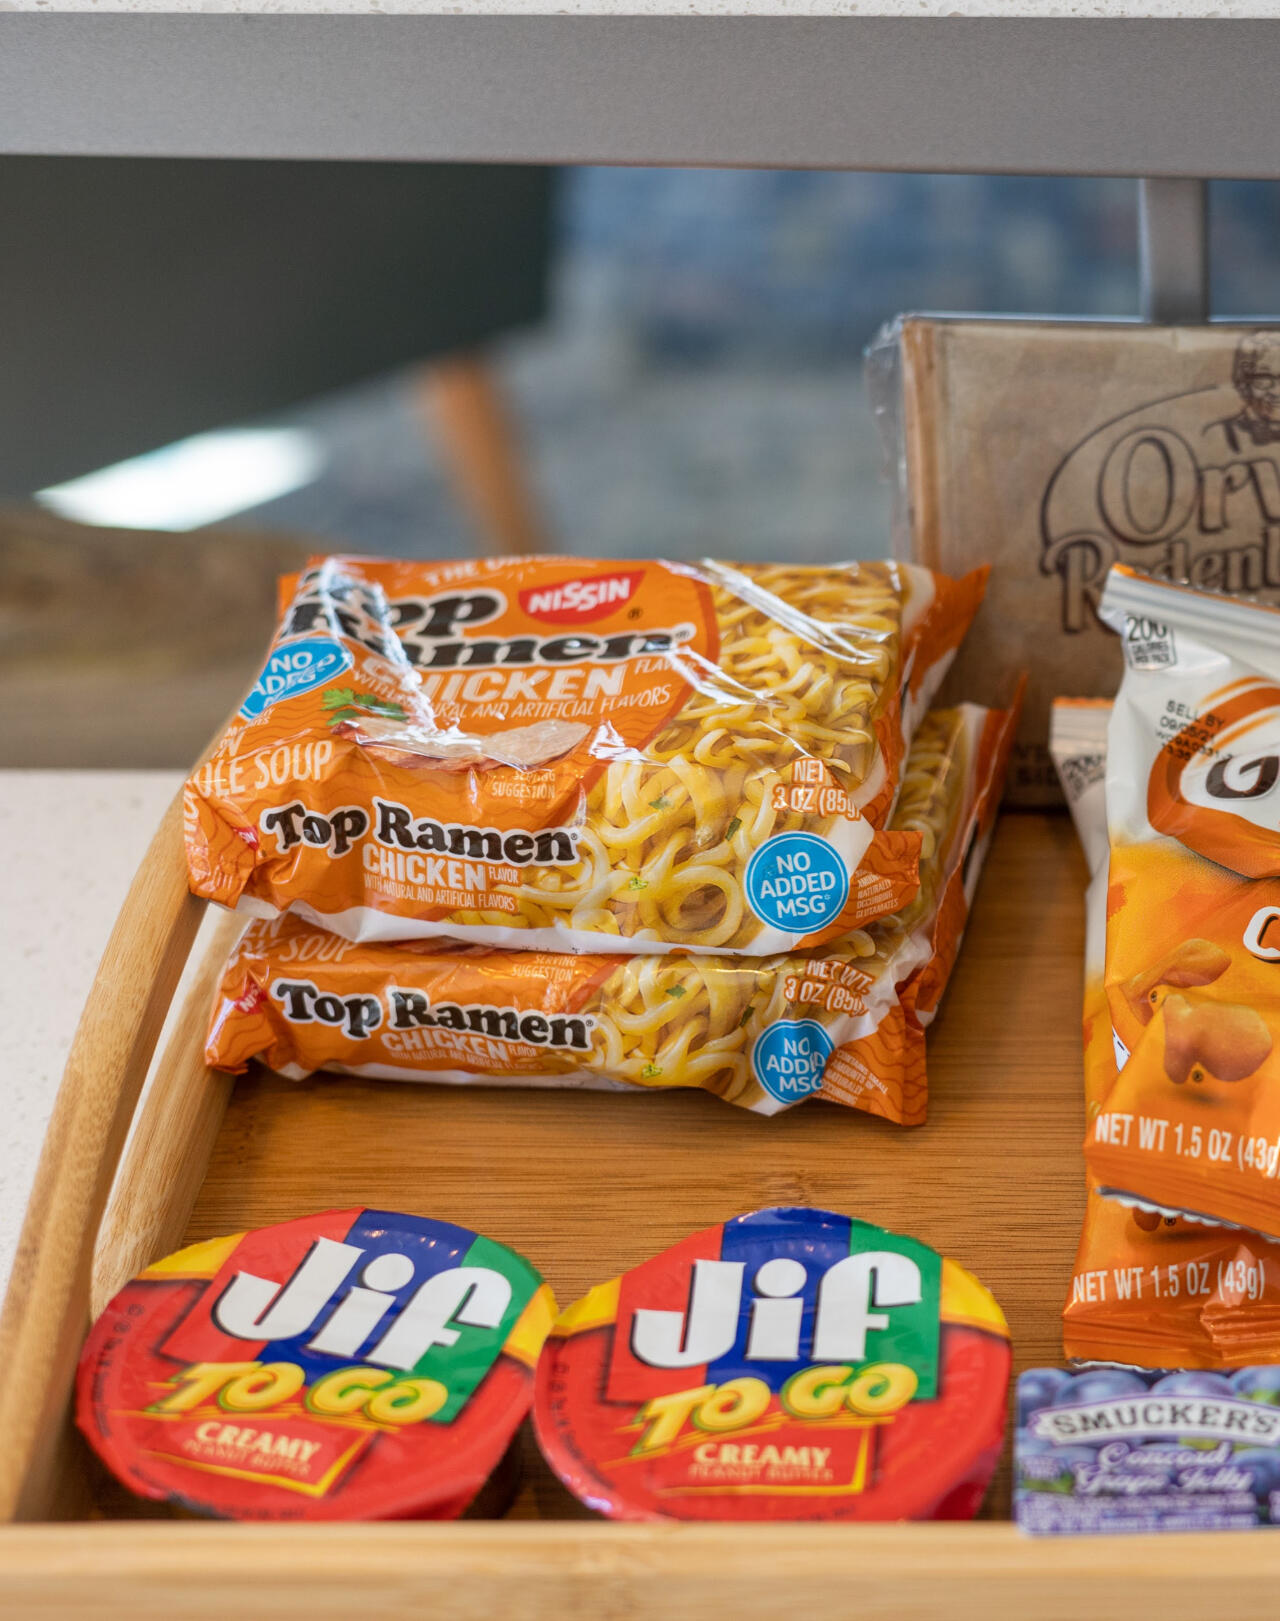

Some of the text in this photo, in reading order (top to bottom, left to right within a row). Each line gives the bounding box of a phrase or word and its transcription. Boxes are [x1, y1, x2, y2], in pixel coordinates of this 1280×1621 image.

[528, 577, 631, 612] NISSIN
[271, 651, 313, 674] NO
[471, 701, 509, 719] AND
[511, 700, 594, 719] ARTIFICIAL
[600, 683, 672, 714] FLAVORS
[1166, 699, 1225, 729] SELL BY
[254, 740, 334, 791] SOUP
[491, 781, 557, 799] SUGGESTION
[773, 785, 786, 810] 3
[791, 787, 814, 811] OZ
[266, 803, 367, 855] Top
[375, 800, 576, 864] Ramen
[362, 843, 518, 891] CHICKEN FLAVOR
[776, 851, 811, 874] NO
[363, 874, 515, 911] WITH NATURAL AND ARTIFICIAL FLAVORS
[760, 871, 837, 900] ADDED
[511, 963, 575, 983] SUGGESTION
[785, 978, 797, 1001] 3
[800, 980, 825, 1003] OZ
[276, 983, 381, 1039] Top
[391, 991, 589, 1049] Ramen
[381, 1029, 538, 1063] CHICKEN FLAVOR
[783, 1036, 810, 1057] NO
[1095, 1113, 1134, 1147] NET
[1138, 1116, 1169, 1152] WT
[1174, 1123, 1203, 1158] 1.5
[1208, 1129, 1233, 1162] OZ
[1073, 1259, 1266, 1303] NET WT 1.5 OZ (43g)
[211, 1236, 512, 1371] Jif
[630, 1251, 923, 1369] Jif
[146, 1361, 449, 1424] TO GO
[630, 1377, 771, 1456] TO
[781, 1362, 918, 1418] GO
[1053, 1401, 1279, 1437] SMUCKER'S
[195, 1421, 322, 1462] CREAMY
[693, 1442, 832, 1468] CREAMY
[1098, 1441, 1233, 1467] Concord
